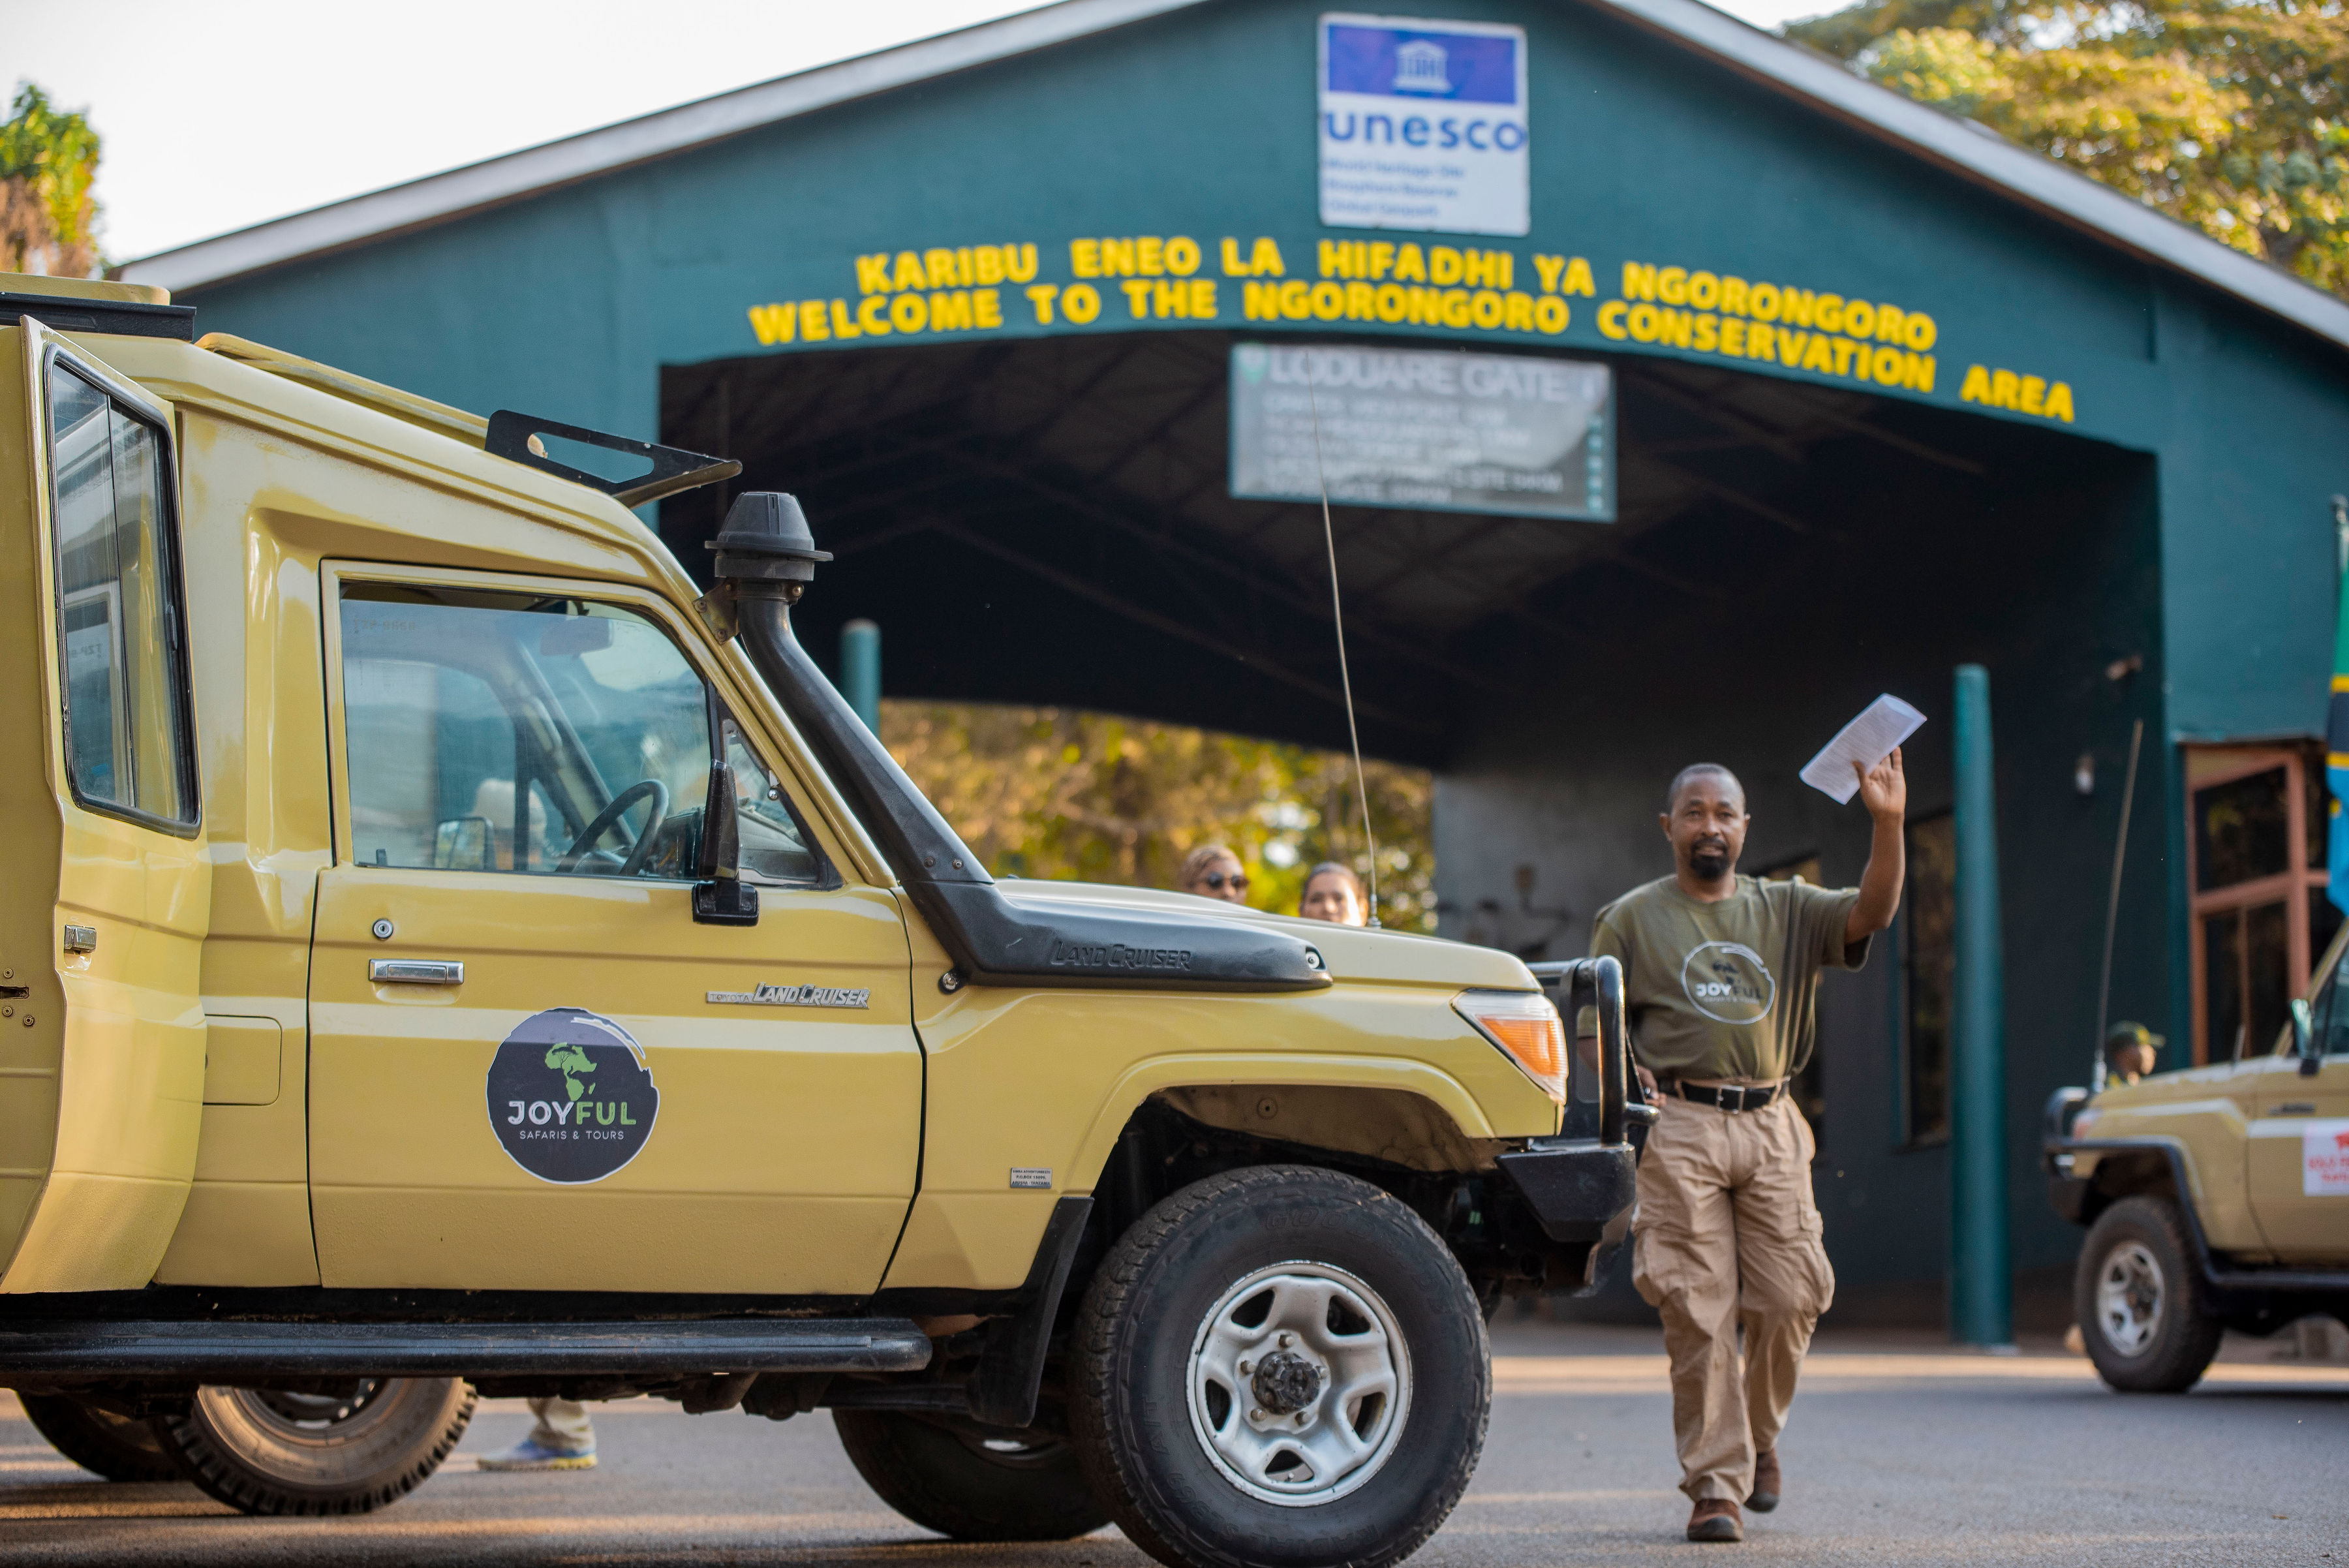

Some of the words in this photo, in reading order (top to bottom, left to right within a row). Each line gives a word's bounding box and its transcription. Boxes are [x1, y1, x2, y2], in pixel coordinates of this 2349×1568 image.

[1325, 112, 1527, 151] unesco
[856, 243, 1037, 295] KARIBU
[1070, 236, 1201, 277] ENEO
[1221, 238, 1284, 277] LA
[1319, 240, 1513, 290] HIFADHI
[1533, 254, 1595, 297] YA
[1622, 262, 1937, 352] NGORONGORO
[748, 288, 1002, 345] WELCOME
[1026, 284, 1101, 324] TO
[1121, 279, 1218, 319] THE
[1243, 280, 1570, 334] NGORONGORO
[1597, 301, 1937, 393] CONSERVATION
[1960, 365, 2074, 423] AREA
[1051, 941, 1107, 966] LAND
[1108, 944, 1191, 972] CRUISER
[711, 993, 750, 1002] TOYOTA
[508, 1100, 637, 1126] JOYFUL
[519, 1130, 568, 1140] SAFARIS
[572, 1131, 580, 1140] &
[586, 1131, 624, 1141] TOURS
